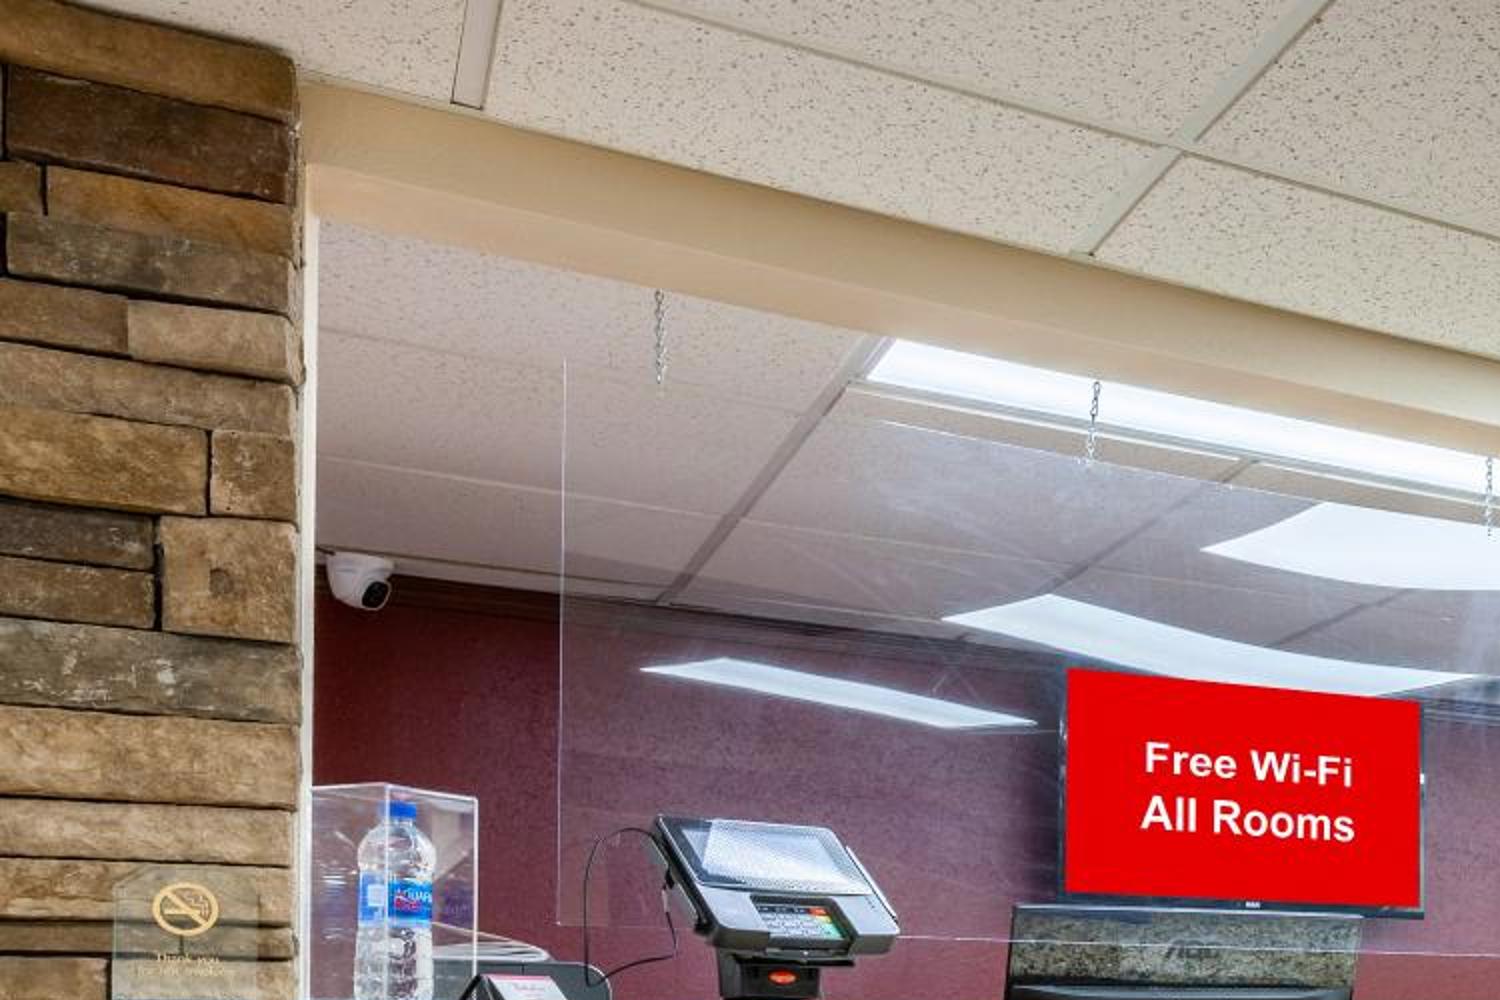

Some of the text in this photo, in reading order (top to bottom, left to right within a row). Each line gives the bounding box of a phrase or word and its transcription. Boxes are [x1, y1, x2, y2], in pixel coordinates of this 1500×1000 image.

[1145, 741, 1353, 788] Free Wi-Fi
[1140, 795, 1356, 843] All Rooms
